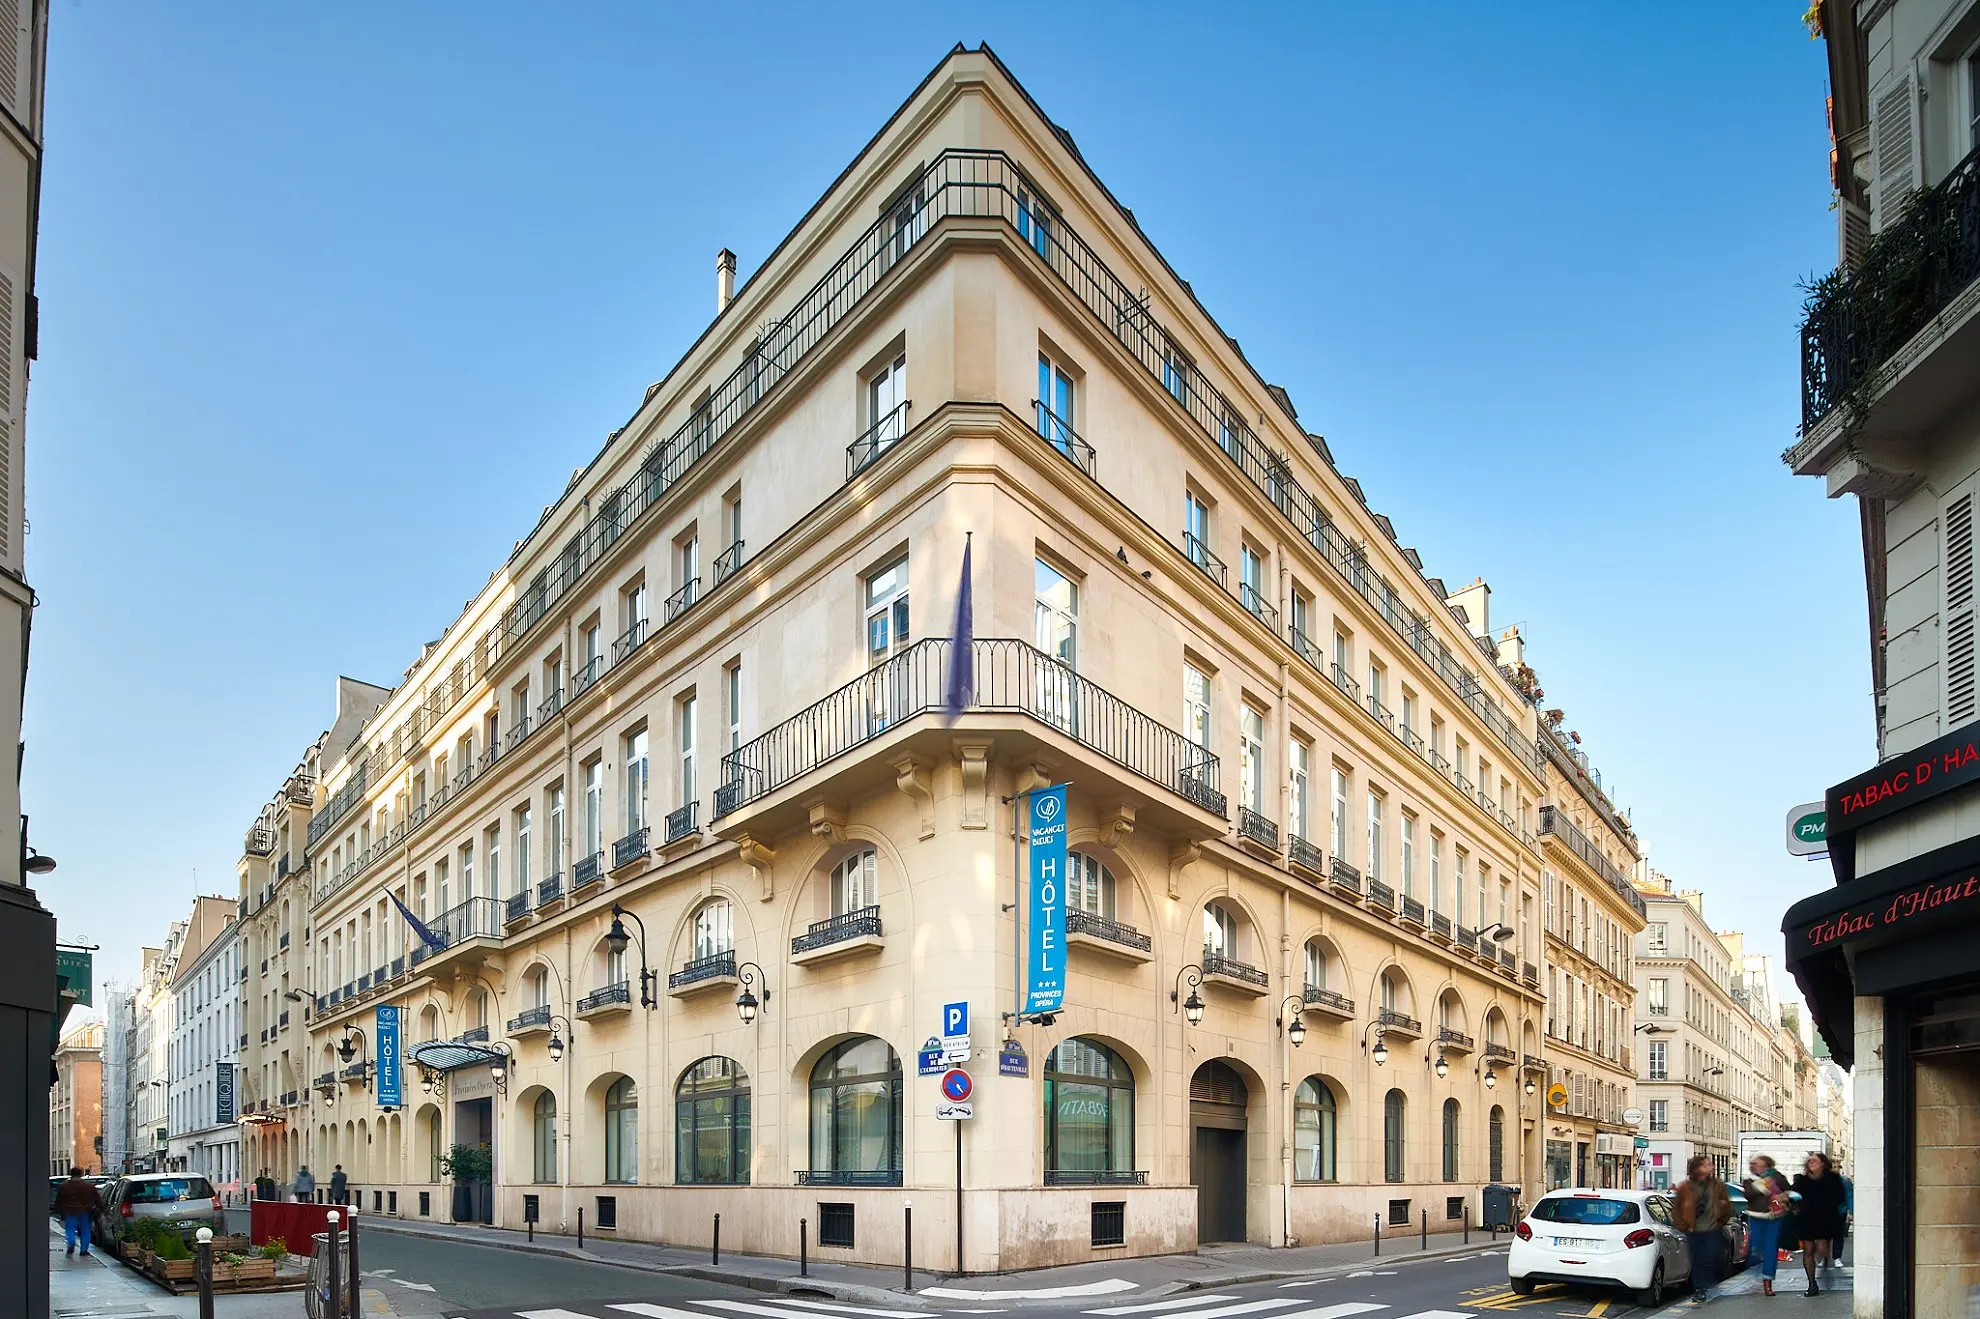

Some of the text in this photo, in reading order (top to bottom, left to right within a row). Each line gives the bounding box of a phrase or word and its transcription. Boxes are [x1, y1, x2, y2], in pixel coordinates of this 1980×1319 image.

[1840, 772, 1909, 815] TABAC
[1944, 743, 1980, 773] HA
[1032, 824, 1065, 836] VACANCES
[1800, 821, 1826, 836] PM
[1032, 836, 1054, 846] BLEUES
[1041, 857, 1056, 972] HÔTEL
[1808, 911, 1875, 946] Tabac
[1030, 990, 1062, 1000] PROVINCES
[1034, 999, 1054, 1008] OPÉRA
[949, 1008, 962, 1032] P
[383, 1035, 393, 1086] HÔTEL
